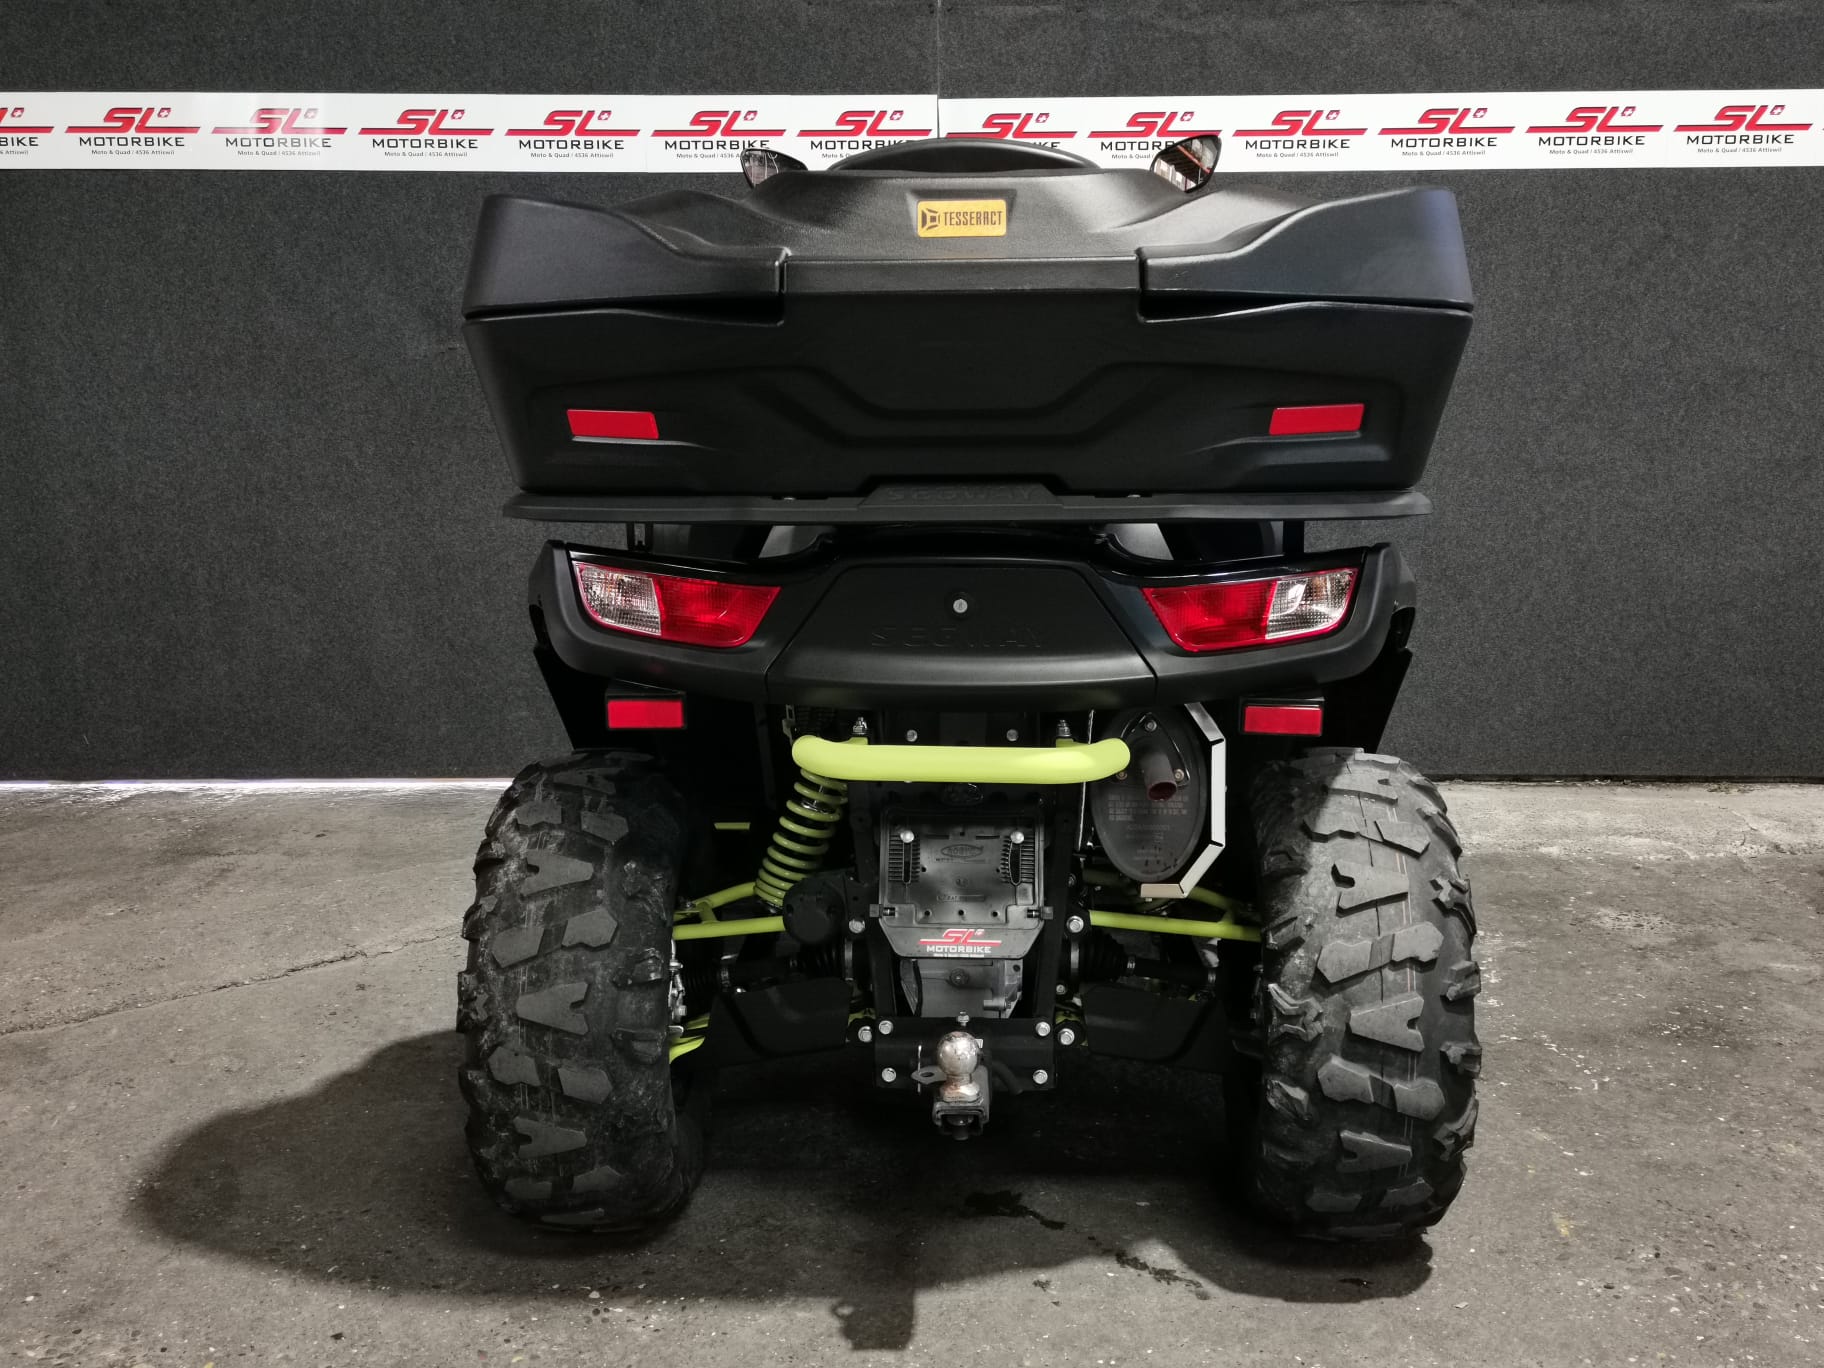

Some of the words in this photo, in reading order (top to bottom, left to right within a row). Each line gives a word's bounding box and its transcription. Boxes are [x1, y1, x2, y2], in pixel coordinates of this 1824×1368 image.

[79, 136, 185, 147] MOTORBIKE
[226, 137, 332, 148] MOTORBIKE
[373, 138, 479, 149] MOTORBIKE
[519, 139, 625, 150] MOTORBIKE
[665, 140, 770, 150] MOTORBIKE
[1245, 139, 1351, 150] MOTORBIKE
[1391, 137, 1498, 148] MOTORBIKE
[1538, 135, 1646, 146] MOTORBIKE
[1686, 134, 1795, 145] MOTORBIKE
[943, 211, 1003, 226] TESSERACT
[926, 945, 992, 954] MOTORBIKE
